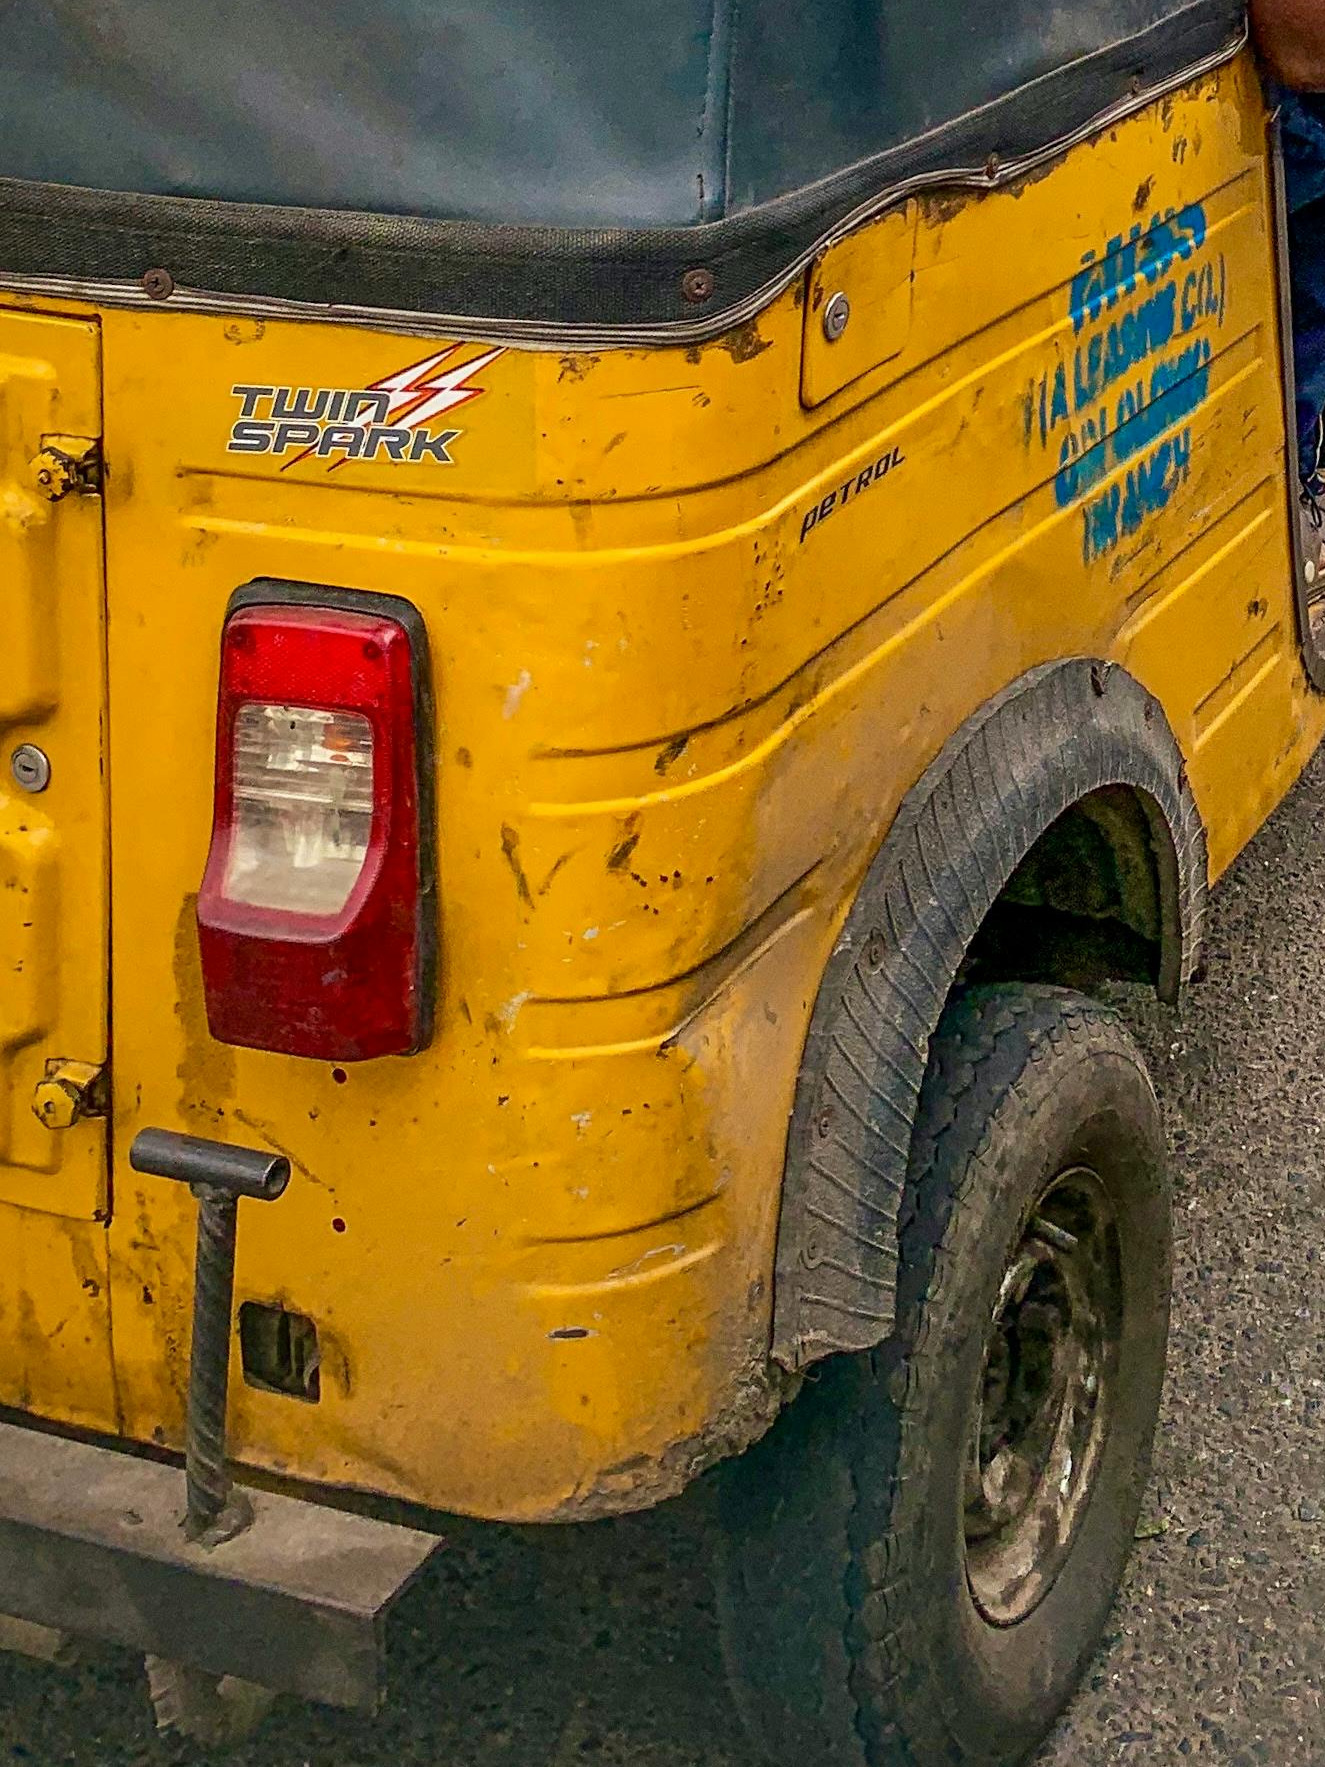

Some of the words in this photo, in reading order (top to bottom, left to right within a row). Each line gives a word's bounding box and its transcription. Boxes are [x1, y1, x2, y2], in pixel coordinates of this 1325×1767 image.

[230, 384, 392, 426] TWIN
[226, 421, 464, 464] SPARK
[799, 445, 907, 545] PETROL
